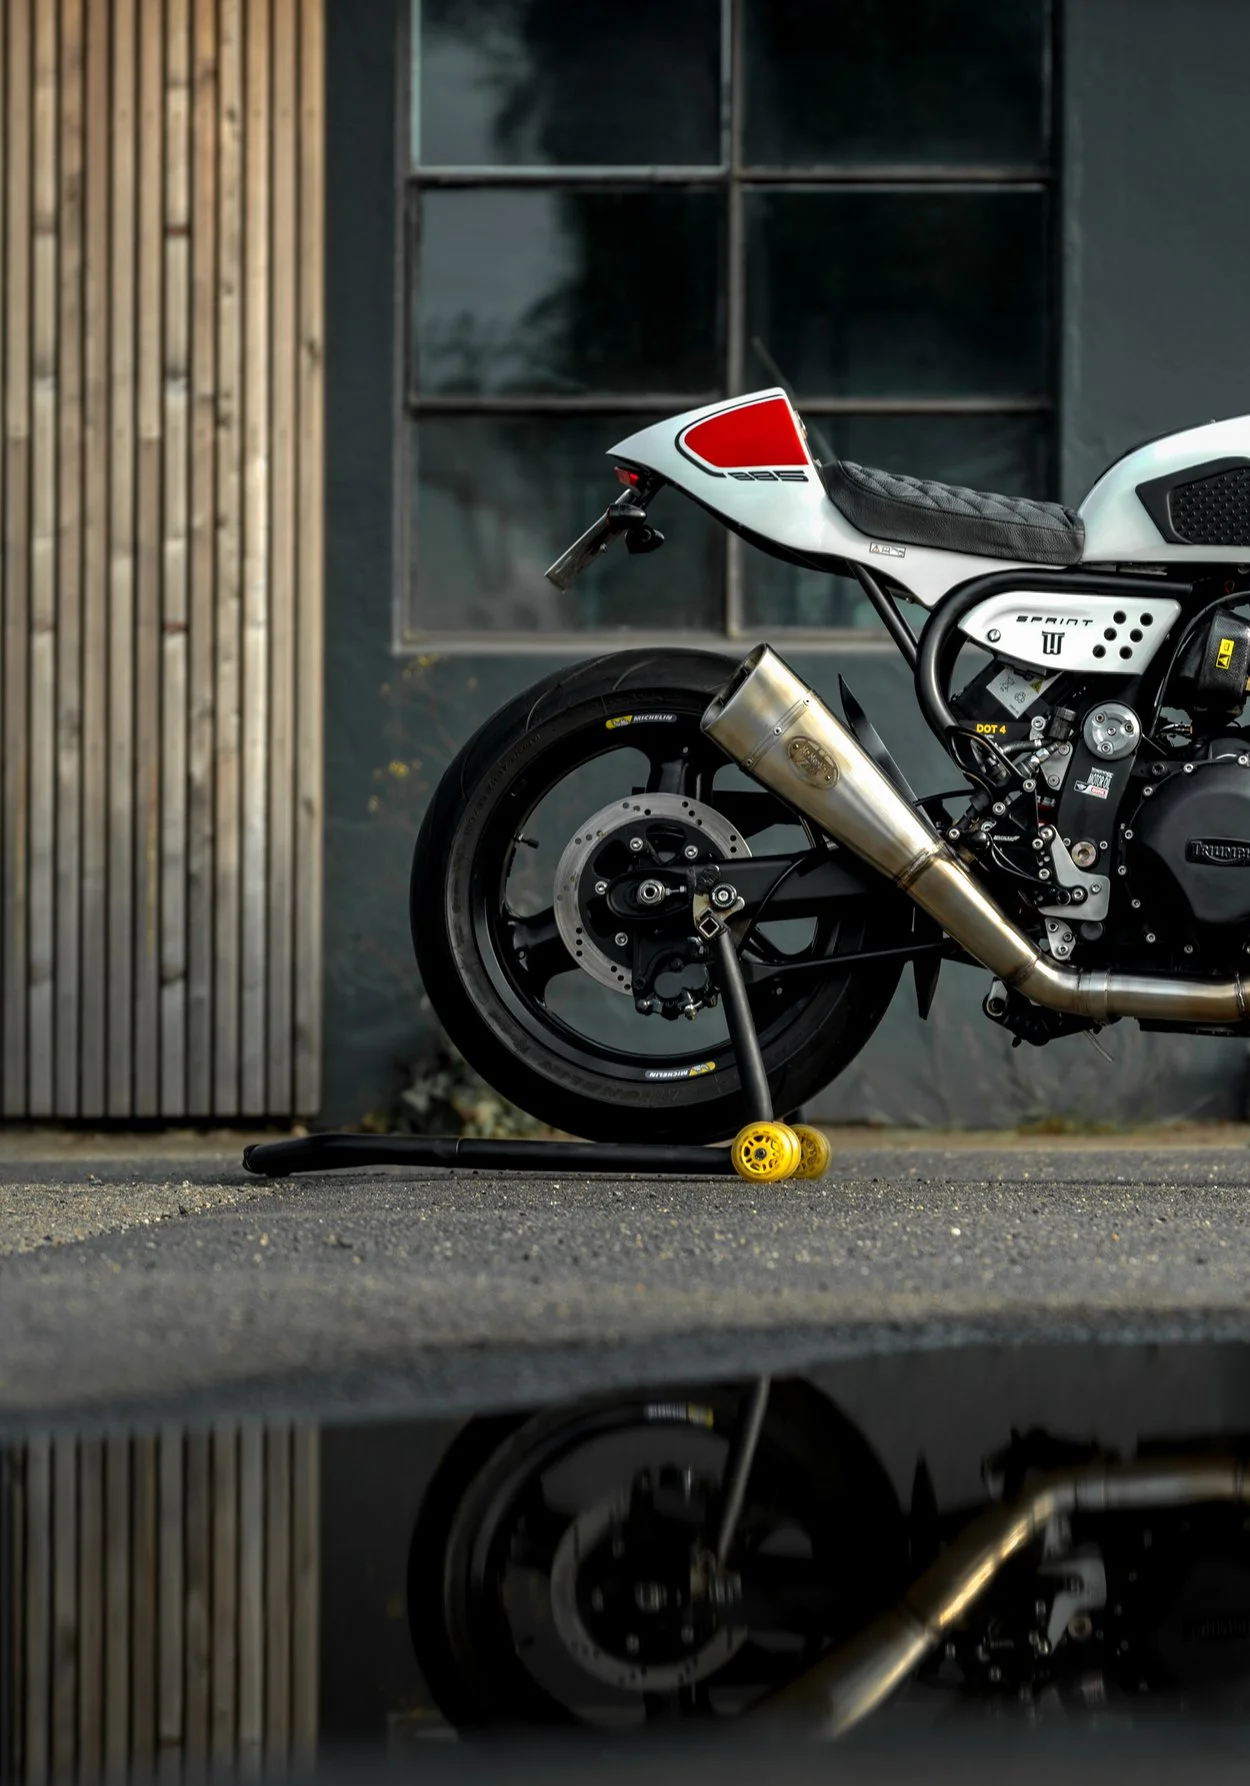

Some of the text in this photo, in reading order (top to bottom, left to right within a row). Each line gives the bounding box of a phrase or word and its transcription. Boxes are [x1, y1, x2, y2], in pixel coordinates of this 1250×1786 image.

[1016, 615, 1093, 627] SPRINT
[633, 714, 673, 722] MICHELIN
[976, 723, 1007, 735] DOT 4
[649, 1069, 689, 1078] MICHELIN
